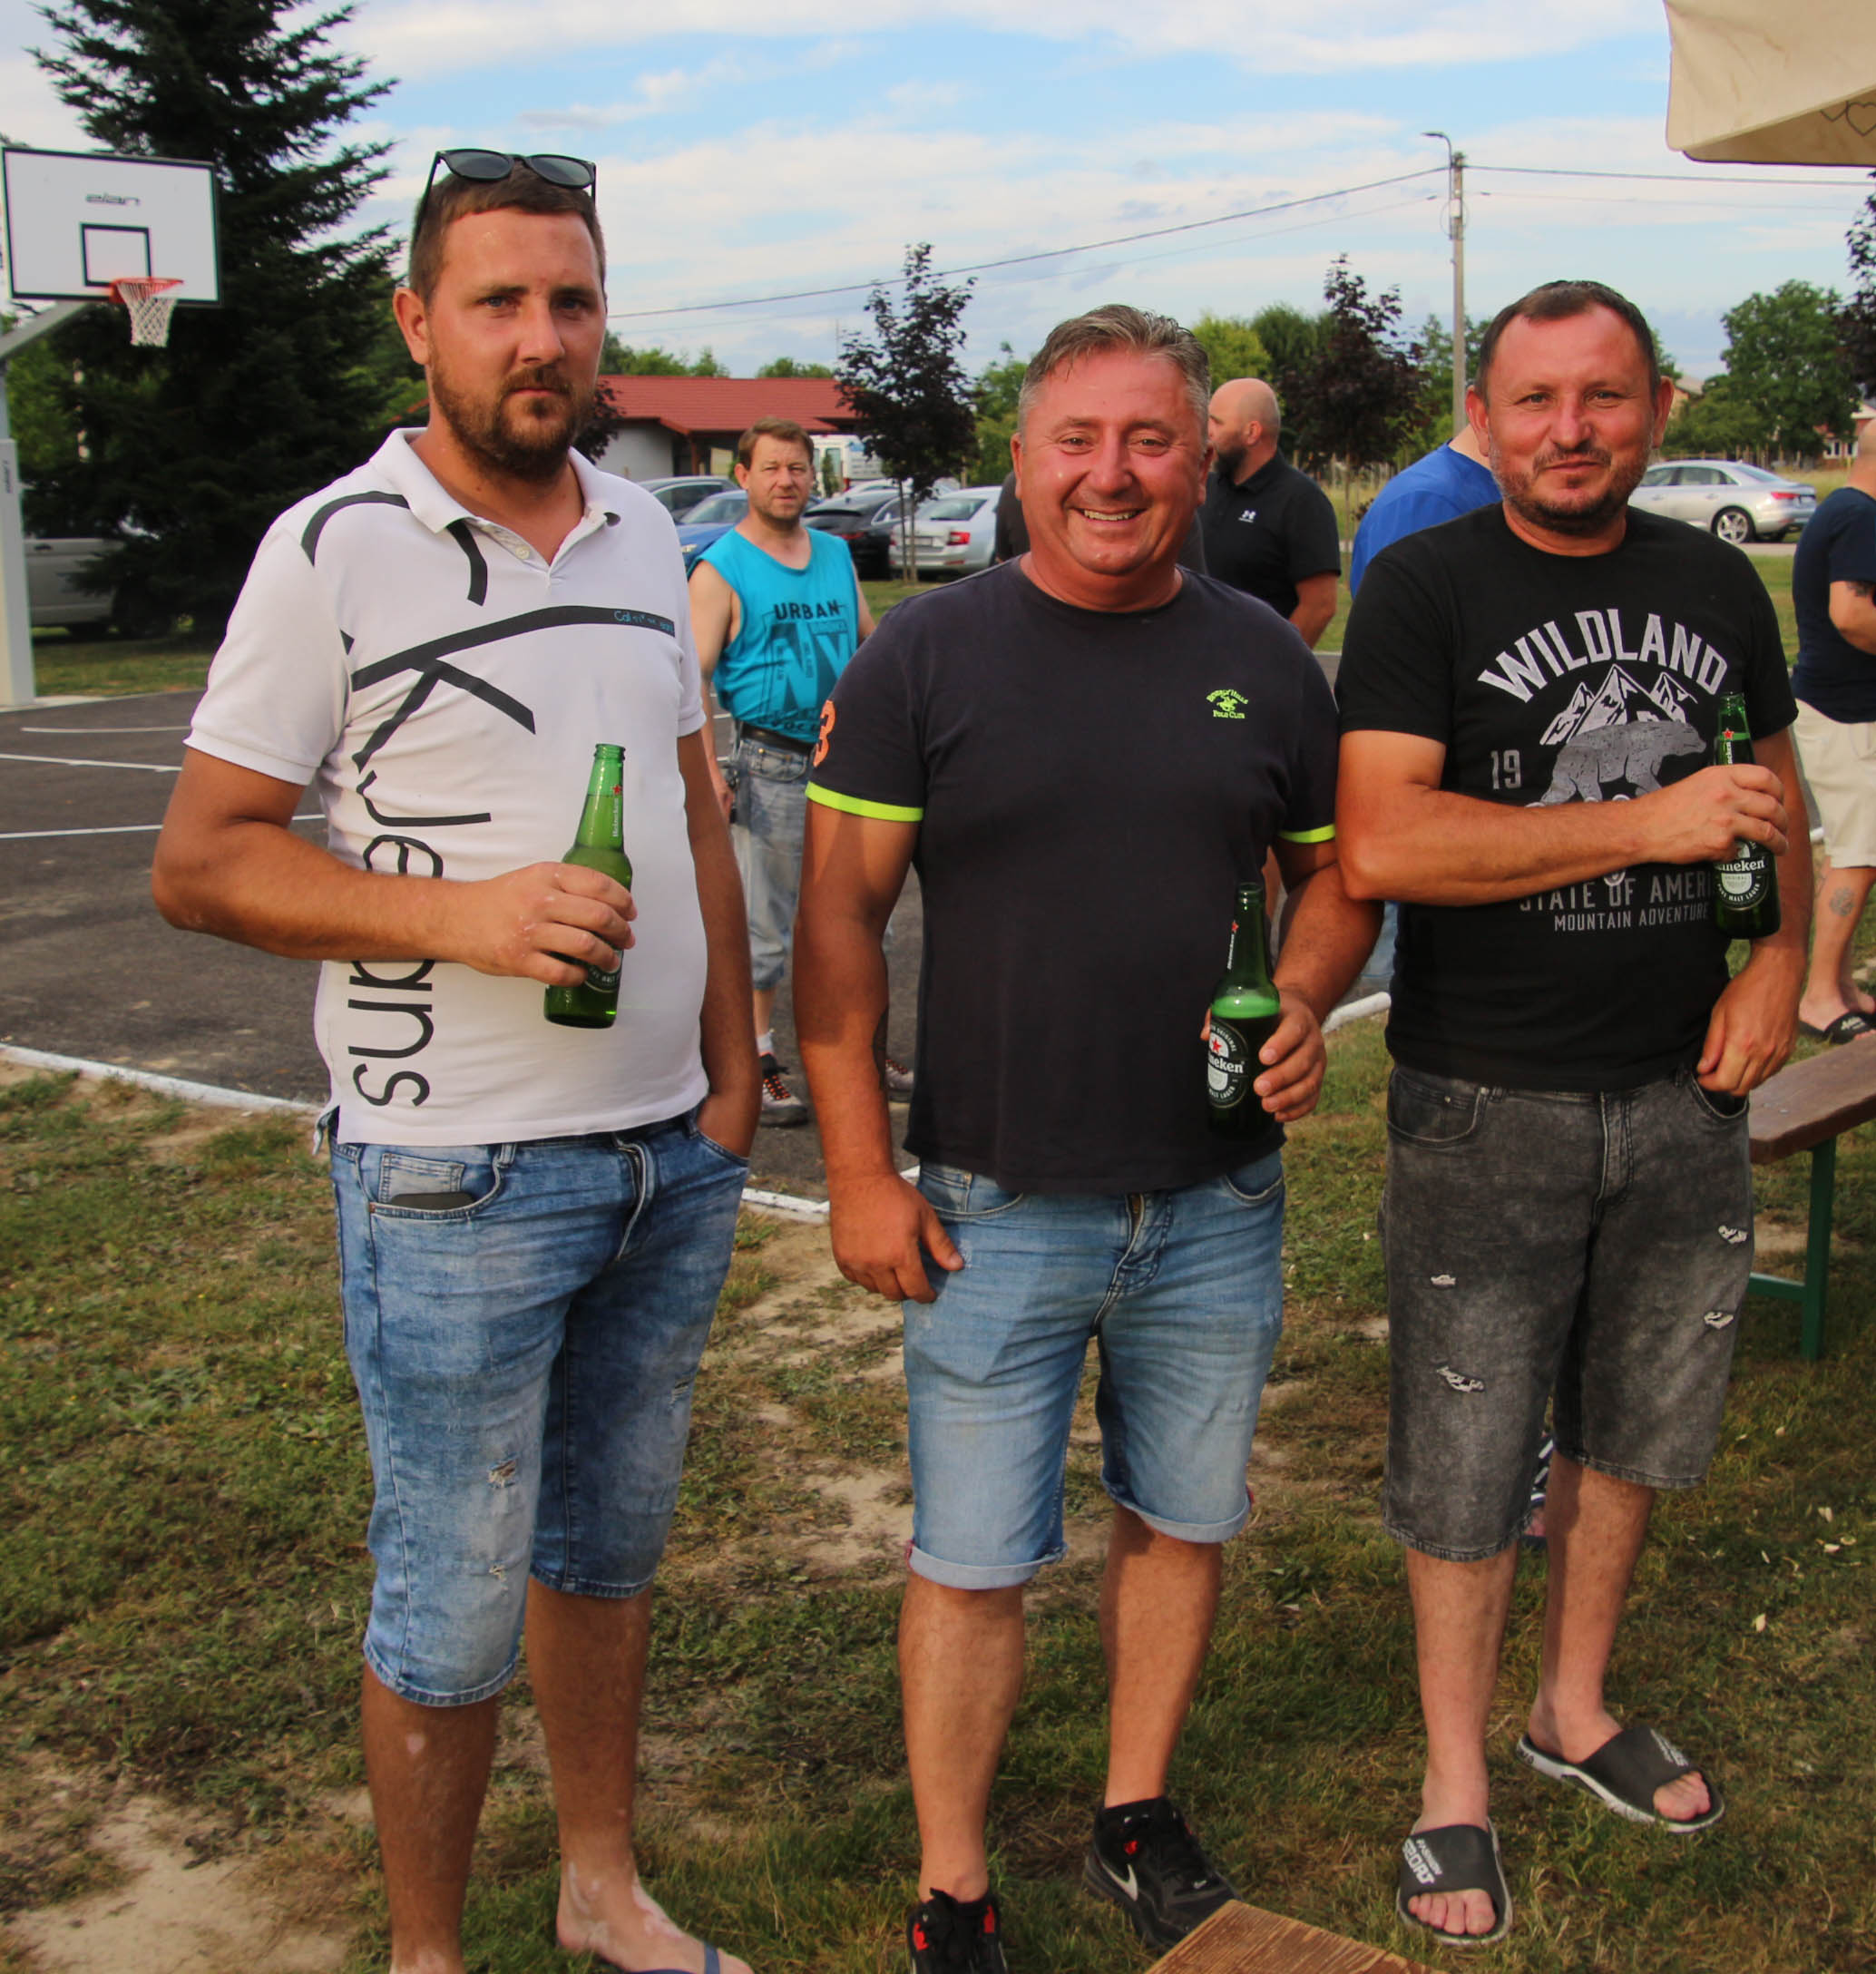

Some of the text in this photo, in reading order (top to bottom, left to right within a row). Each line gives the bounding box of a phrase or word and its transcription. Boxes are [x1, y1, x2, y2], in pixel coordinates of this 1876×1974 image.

[774, 600, 841, 620] URBAN
[1478, 609, 1727, 703] WILDLAND
[1490, 749, 1522, 789] 19
[1714, 858, 1765, 872] ineken
[1608, 877, 1636, 906] OF
[1554, 911, 1631, 932] MOUNTAIN
